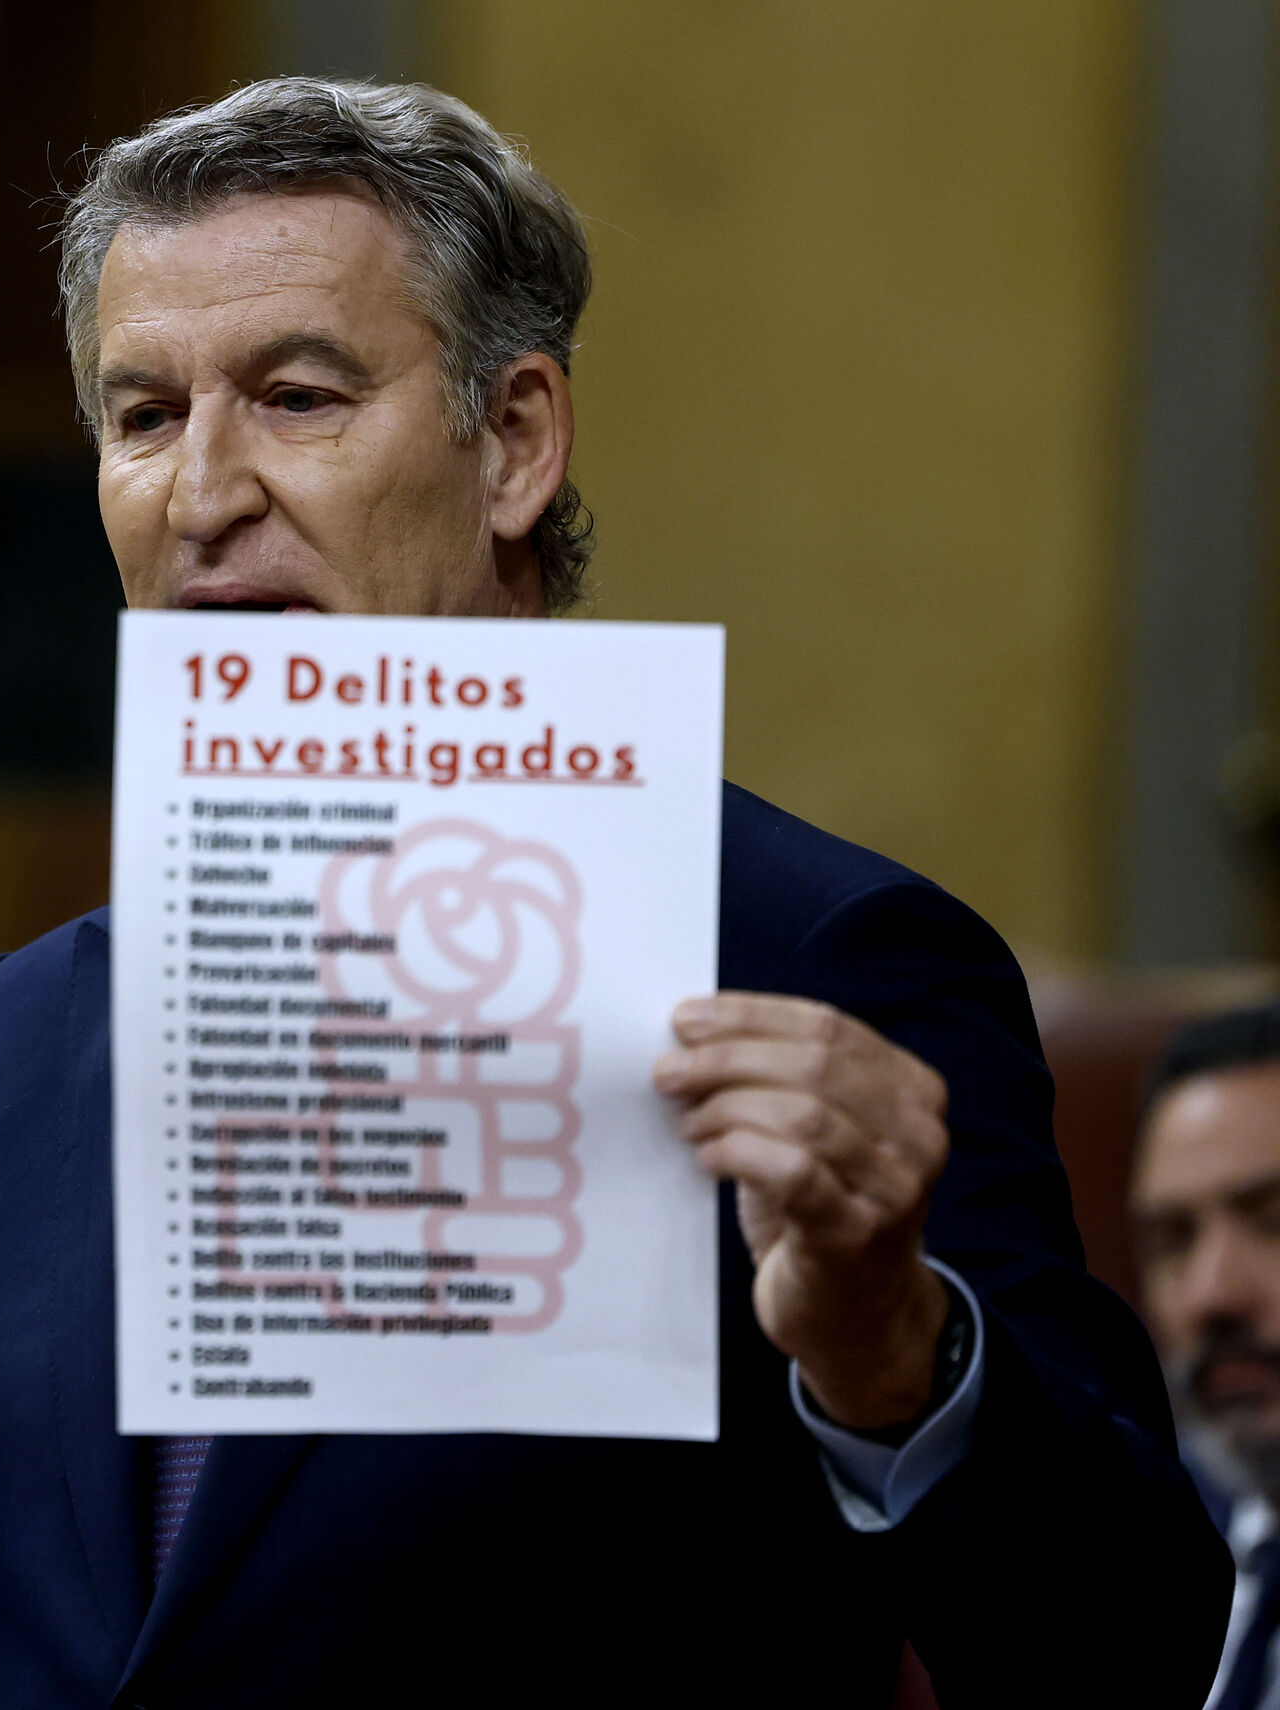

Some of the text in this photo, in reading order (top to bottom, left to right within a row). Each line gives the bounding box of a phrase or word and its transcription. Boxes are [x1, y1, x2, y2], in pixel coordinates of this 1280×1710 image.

[184, 654, 524, 708] 19 Delitos
[183, 718, 636, 787] investigados
[263, 833, 281, 850] de
[283, 932, 301, 949] de
[301, 1157, 319, 1174] de
[234, 1315, 253, 1332] de
